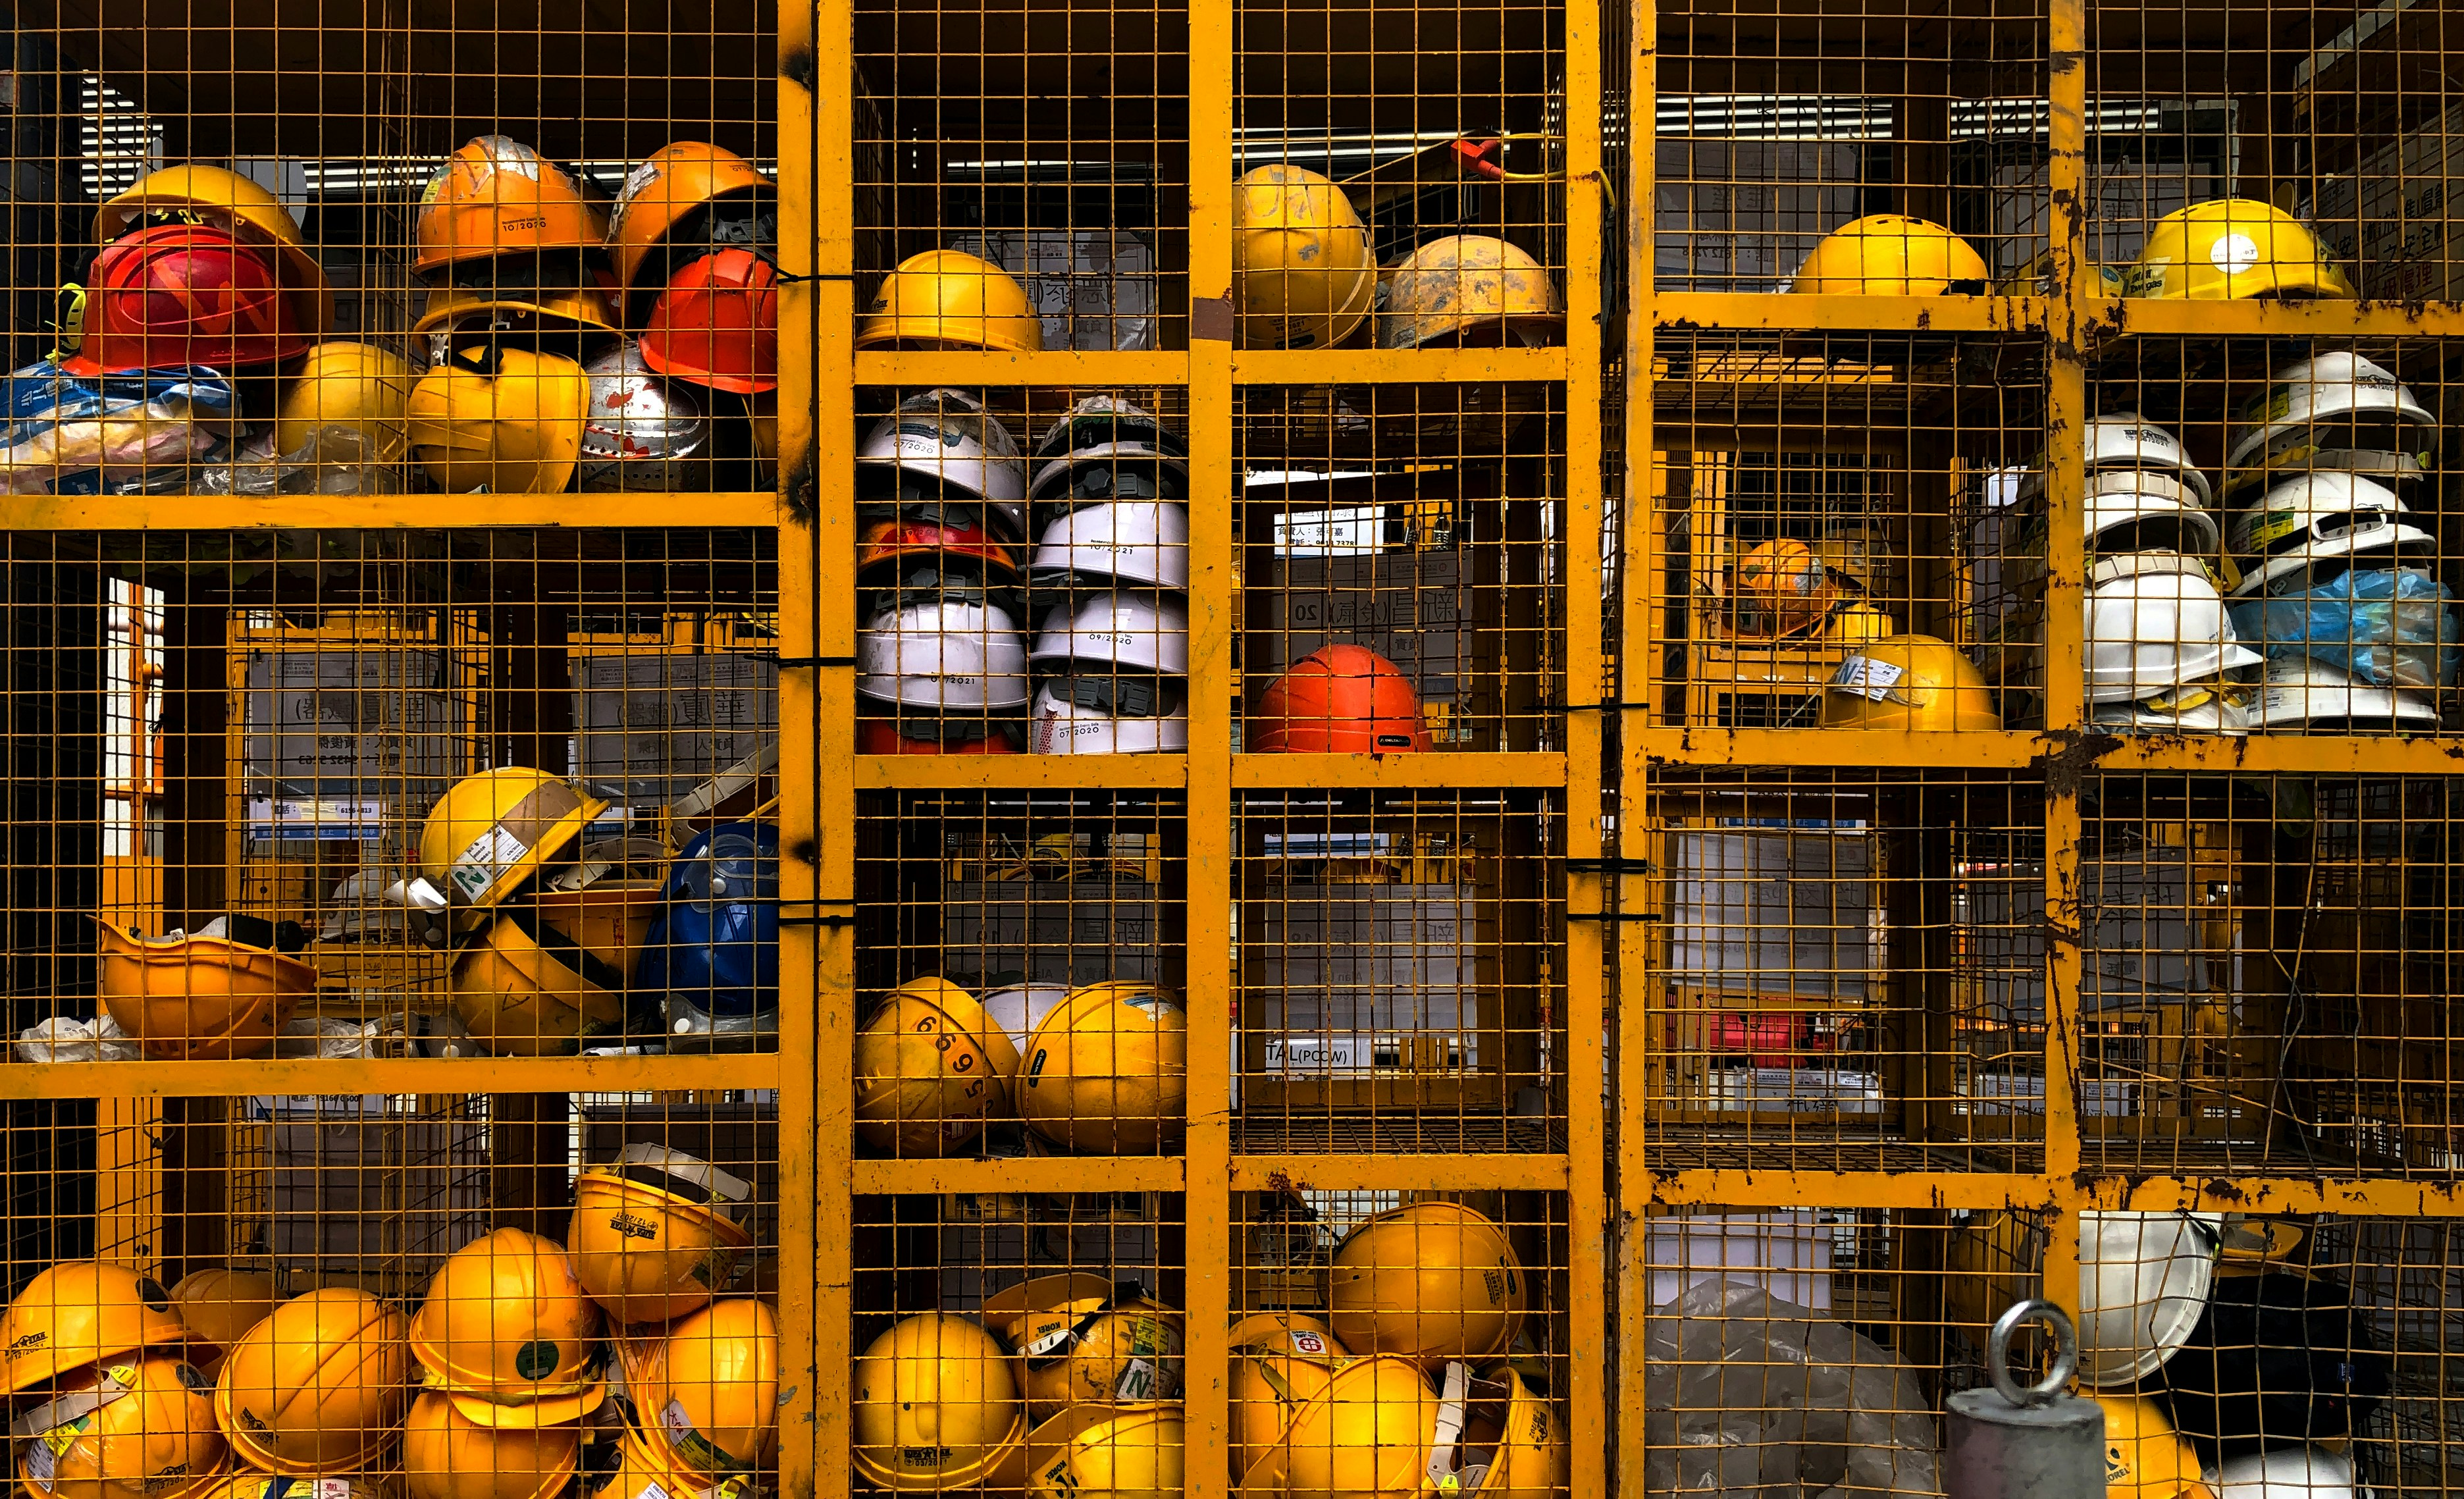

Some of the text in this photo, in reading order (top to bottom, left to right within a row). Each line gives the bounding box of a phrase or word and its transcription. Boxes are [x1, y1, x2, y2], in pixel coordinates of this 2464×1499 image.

[503, 221, 546, 232] 10/2020
[2130, 279, 2163, 294] Towgas
[931, 676, 975, 685] 0/2021
[1059, 727, 1099, 738] 072020
[1265, 1045, 1348, 1065] TAL(PCCW)
[1037, 1321, 1061, 1334] KOREL
[1045, 1460, 1067, 1481] KOREL
[2106, 1467, 2131, 1482] OREL
